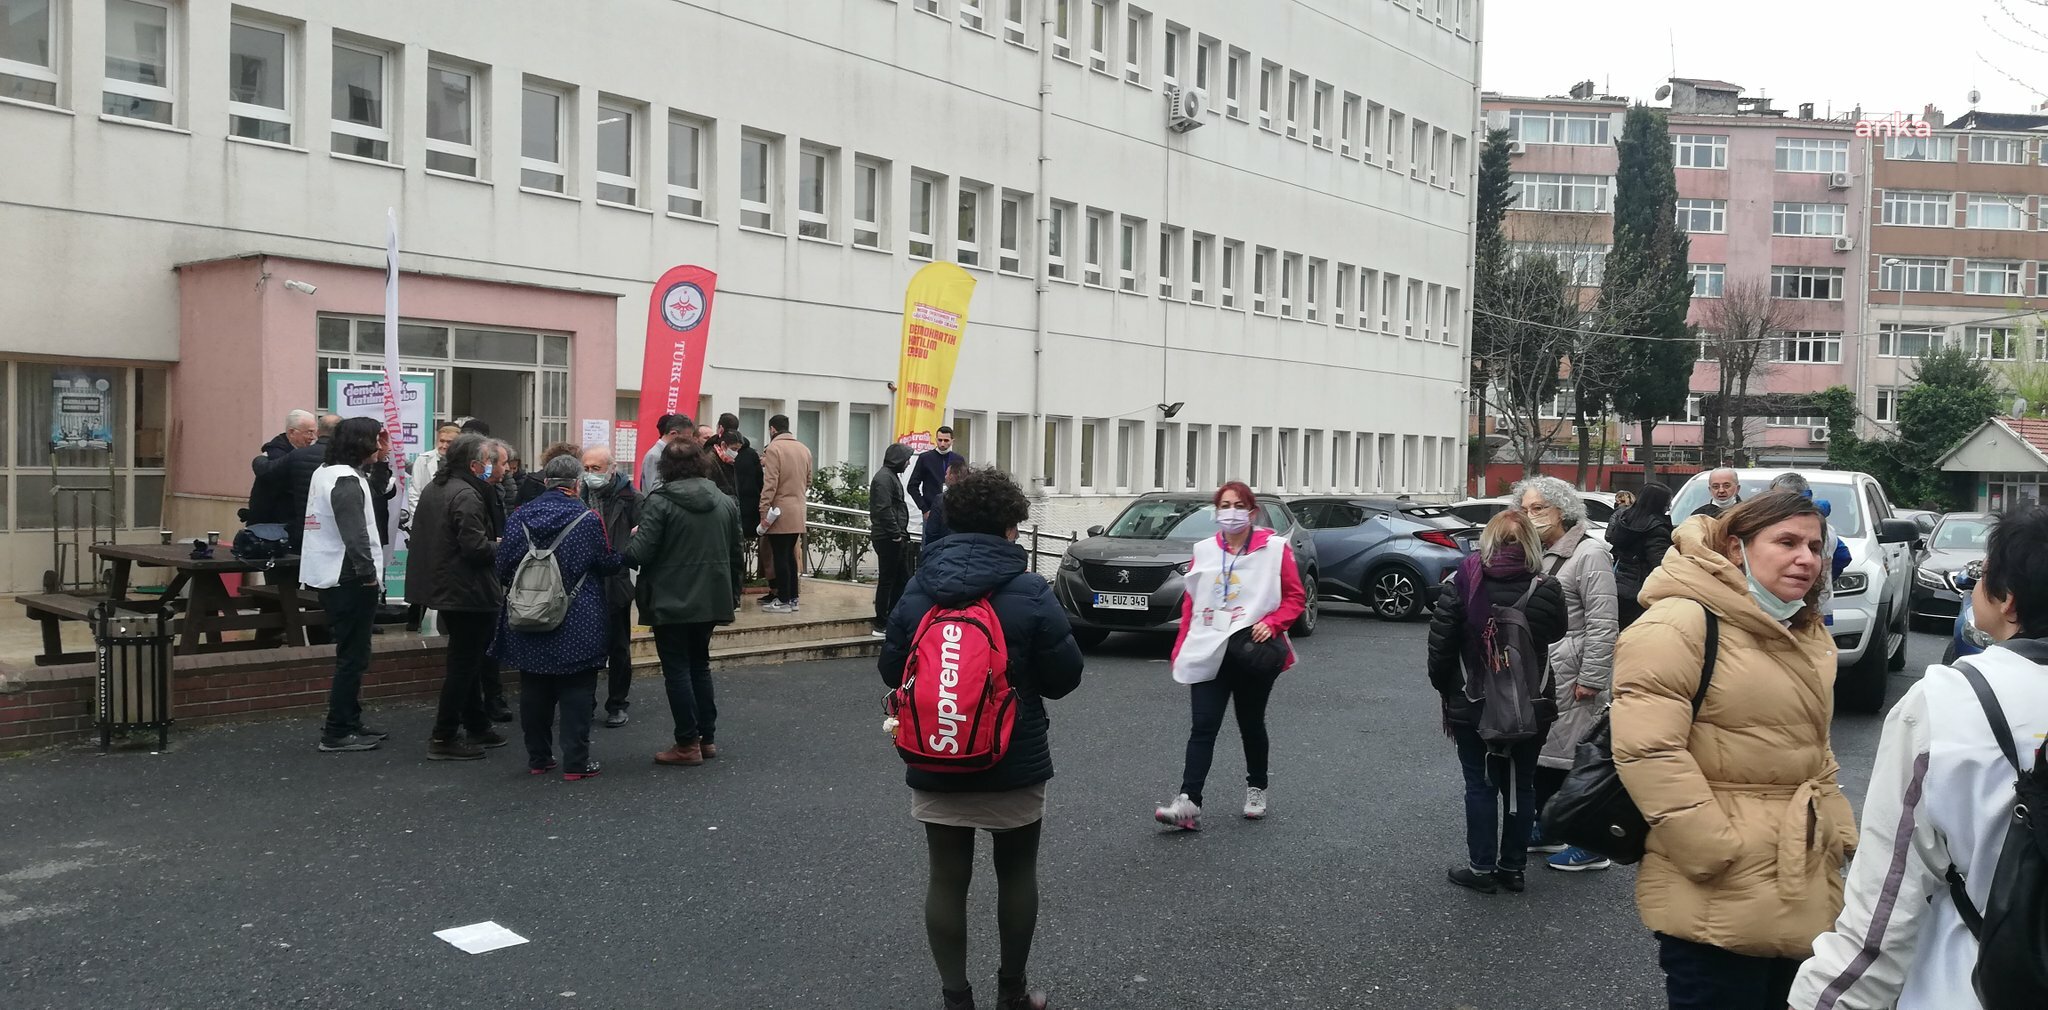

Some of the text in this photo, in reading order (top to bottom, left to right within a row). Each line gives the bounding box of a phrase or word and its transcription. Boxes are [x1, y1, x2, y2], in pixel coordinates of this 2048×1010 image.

[670, 341, 686, 384] TÜRK
[1099, 595, 1146, 606] 34 EUZ 349
[929, 624, 966, 755] Supreme
